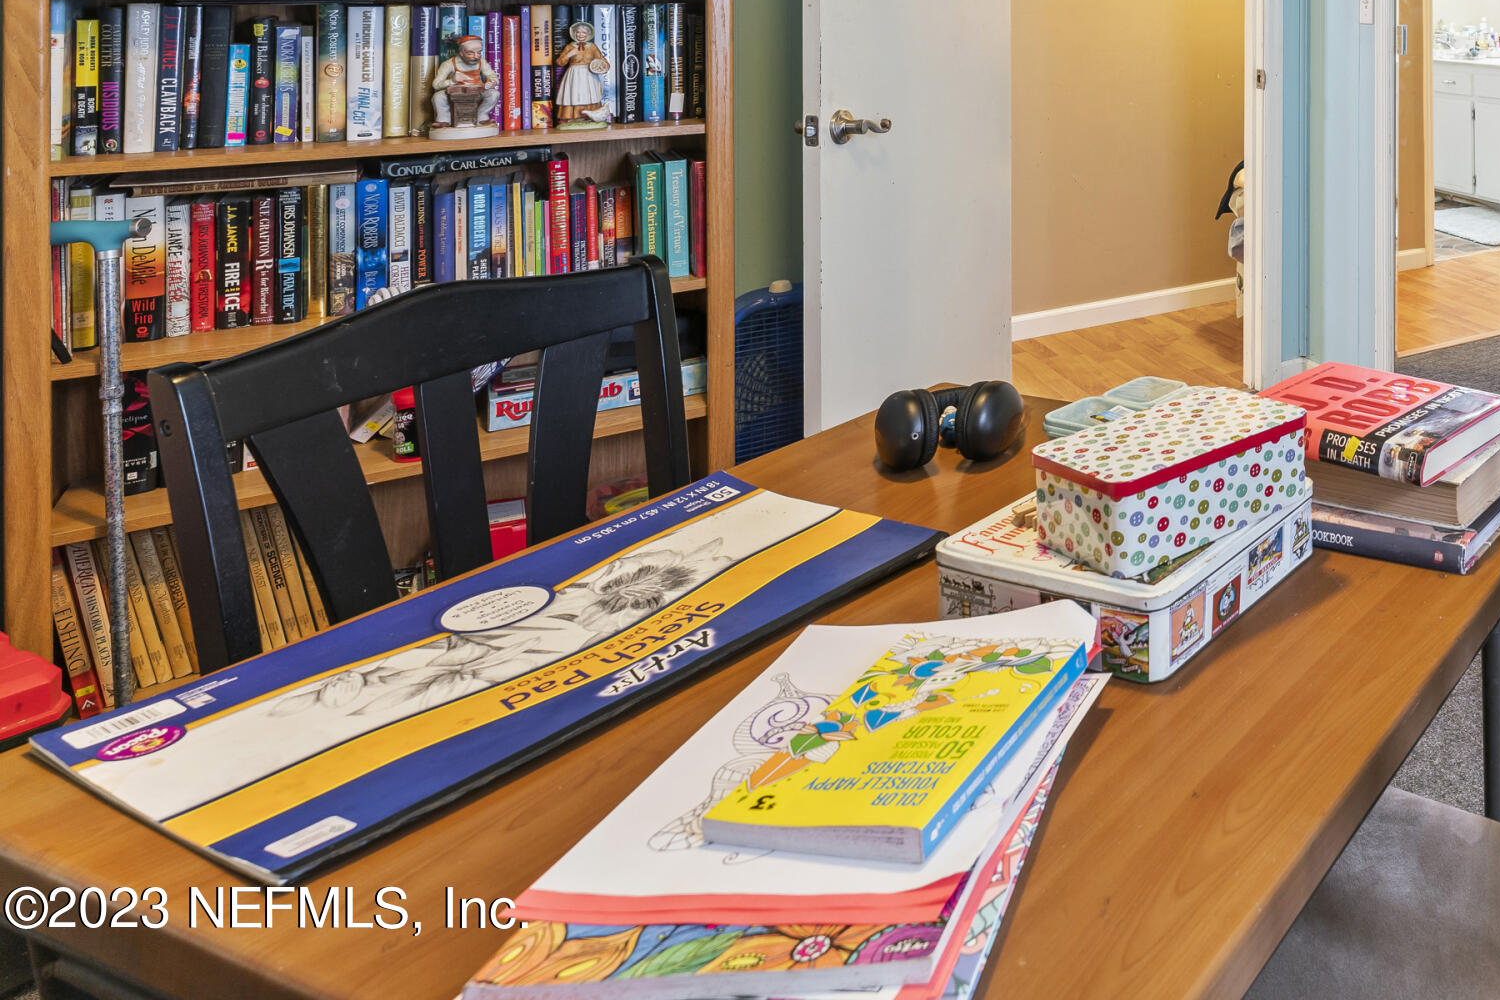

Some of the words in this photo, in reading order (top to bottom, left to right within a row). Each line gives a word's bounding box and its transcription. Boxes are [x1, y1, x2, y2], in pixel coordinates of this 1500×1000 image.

[141, 10, 151, 36] ASHLEY
[328, 9, 339, 31] NORA
[626, 7, 637, 25] NORA
[647, 8, 655, 22] JULIE
[101, 23, 113, 68] COULTER
[140, 37, 149, 55] JUDD
[280, 40, 294, 59] NORA
[328, 32, 338, 60] ROBERTS
[626, 25, 636, 53] ROBERTS
[161, 38, 178, 70] JANCE
[256, 46, 268, 74] Baldacci
[280, 61, 295, 92] ROBERTS
[543, 70, 551, 97] MEMORY
[358, 87, 371, 109] FINAL
[534, 79, 542, 98] DEATH
[77, 101, 85, 118] DEATH
[87, 97, 95, 113] BORN
[102, 81, 119, 131] INSIDIOUS
[159, 78, 177, 134] CLAWBACK
[626, 93, 636, 112] ROBB
[353, 110, 366, 126] CUT
[450, 160, 478, 171] CARL
[480, 156, 513, 168] SAGAN
[551, 171, 567, 197] JANET
[645, 170, 657, 201] Merry
[671, 168, 683, 208] Treasury
[259, 200, 271, 217] SUE
[284, 205, 296, 221] IRIS
[364, 193, 380, 215] NORA
[394, 191, 405, 213] DAVID
[474, 193, 486, 213] NORA
[168, 209, 181, 224] J.A.
[226, 205, 238, 223] J.A.
[551, 199, 568, 249] EVANOVICH
[674, 209, 683, 219] of
[199, 224, 208, 237] IRIS
[226, 225, 238, 253] JANCE
[259, 218, 271, 257] GRAFTON
[283, 221, 295, 258] JOHANSEN
[360, 217, 380, 249] ROBERTS
[394, 214, 405, 248] BALDACCI
[474, 215, 486, 248] ROBERTS
[647, 204, 658, 255] Christmas
[674, 218, 684, 254] Virtues
[168, 228, 183, 257] JANCE
[132, 245, 156, 285] DeMille
[198, 237, 209, 271] JOHANSEN
[255, 258, 274, 271] R
[418, 249, 426, 278] POWER
[225, 262, 240, 287] FIRE
[391, 265, 399, 288] CORNE
[480, 259, 488, 279] SHELTE
[283, 273, 295, 293] FATAL
[131, 299, 156, 312] Wild
[198, 282, 209, 318] FIRESTORM
[225, 292, 240, 312] ICE
[283, 293, 295, 311] TIDE
[134, 312, 153, 325] Fire
[1281, 376, 1380, 412] J.D.
[1316, 378, 1441, 430] ROBB
[1375, 410, 1429, 438] PROMISES
[1428, 400, 1441, 412] IN
[1327, 432, 1377, 455] PROSES
[1327, 447, 1338, 460] IN
[694, 485, 707, 493] IN
[706, 480, 720, 489] 18
[711, 488, 733, 500] 50
[662, 500, 678, 509] IN
[673, 496, 688, 504] 12
[621, 517, 637, 526] cm
[638, 508, 659, 520] 45.7
[574, 536, 592, 545] cm
[591, 527, 616, 539] 30.5
[1312, 529, 1354, 547] OOKBOOK
[267, 550, 285, 590] SCIENCE
[86, 596, 105, 636] HISTORIC
[651, 604, 693, 627] Bloc
[53, 607, 87, 673] FISHING
[598, 600, 725, 665] Sketch
[604, 626, 647, 651] para
[95, 636, 112, 667] PLACES
[503, 652, 598, 693] bocetos
[498, 669, 592, 710] Pad
[104, 728, 168, 757] Pacon
[901, 724, 963, 739] COLOR
[962, 724, 987, 739] TO
[935, 740, 975, 760] 50
[860, 761, 956, 776] POSTCARDS
[801, 776, 862, 791] HAPPY
[857, 776, 942, 791] YOURSELF
[870, 792, 929, 807] COLOR
